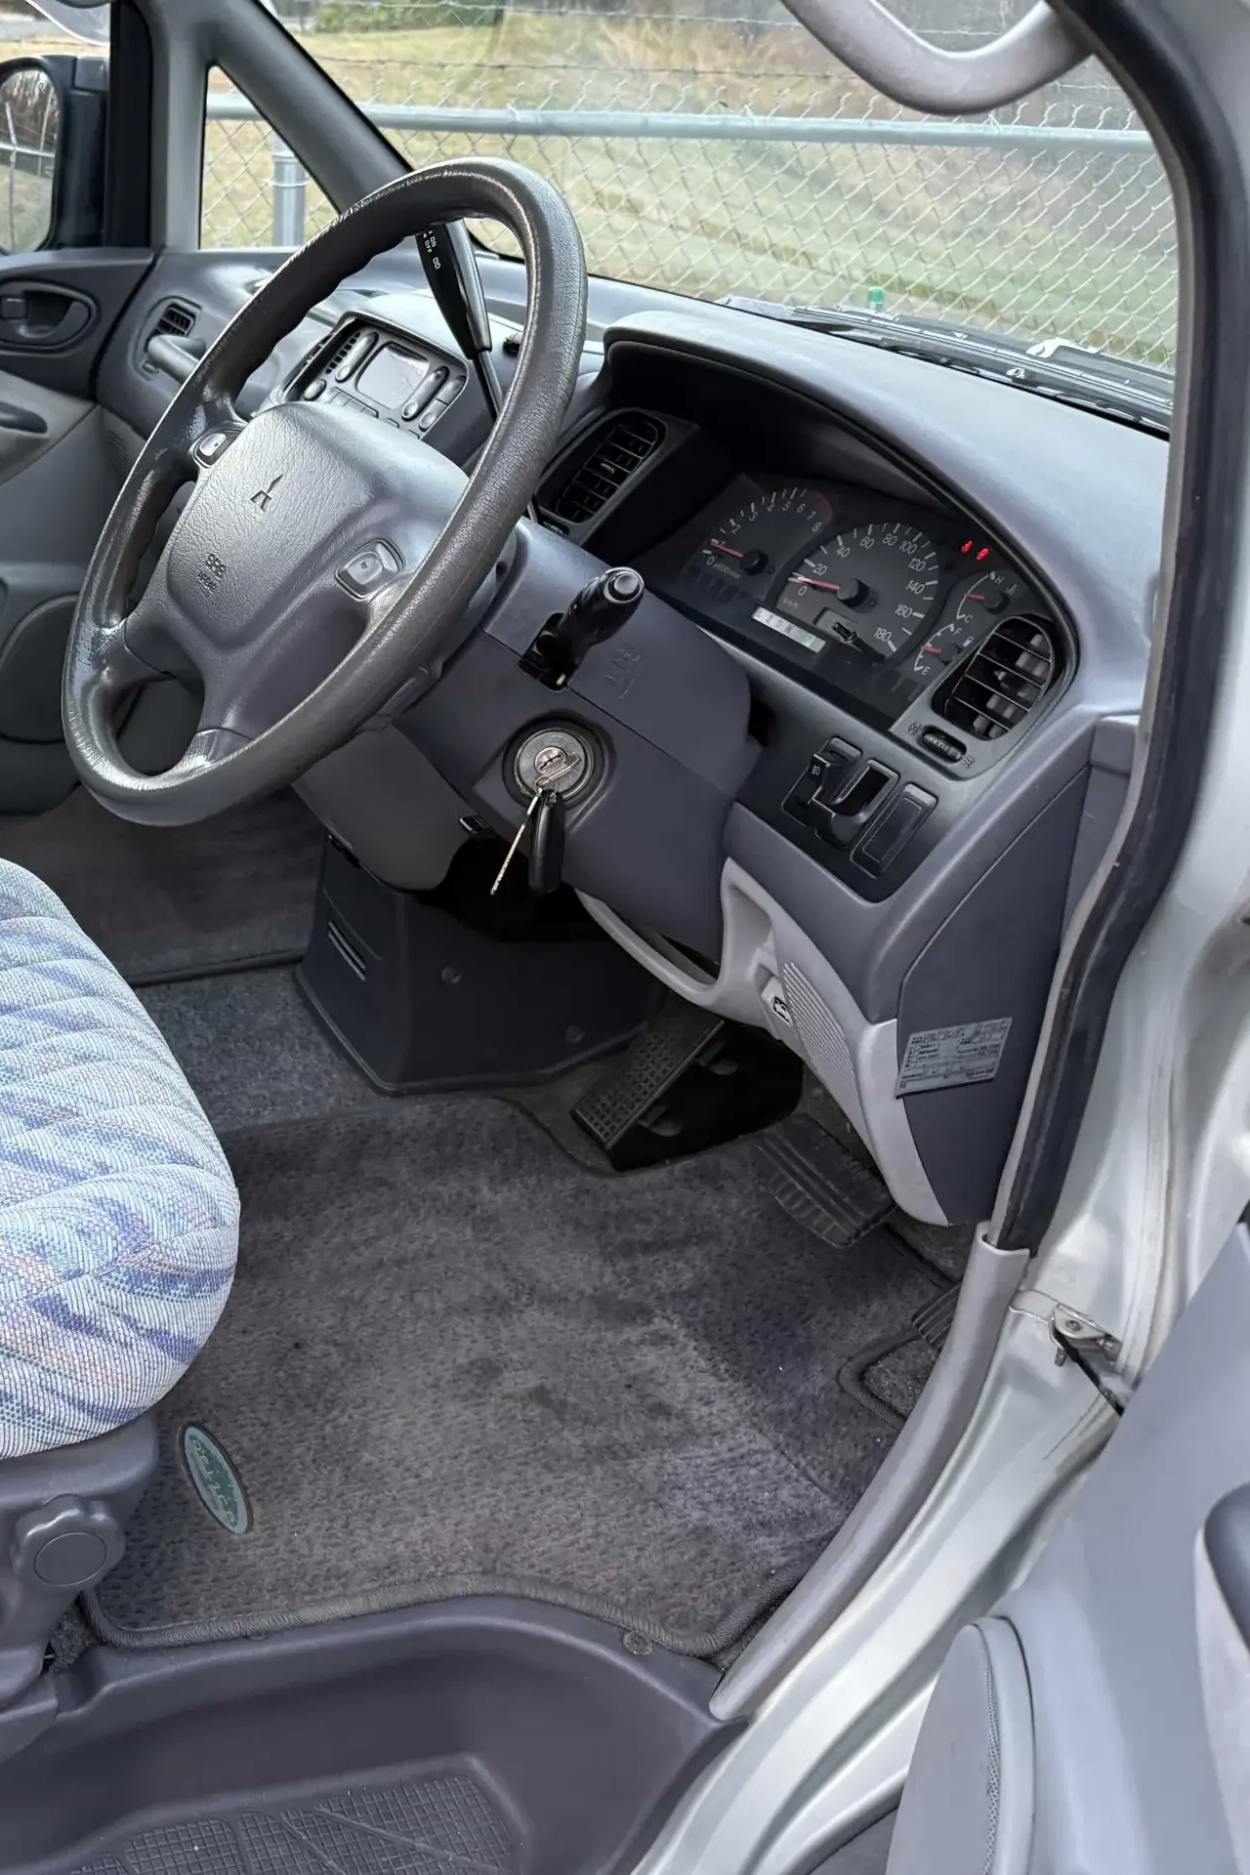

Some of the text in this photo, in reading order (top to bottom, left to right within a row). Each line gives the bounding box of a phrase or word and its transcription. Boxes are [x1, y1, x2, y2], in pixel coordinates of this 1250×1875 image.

[782, 501, 791, 512] 5
[796, 503, 806, 514] 6
[748, 511, 758, 521] 3
[807, 510, 817, 520] 7
[731, 524, 741, 534] 2
[812, 521, 822, 532] 8
[860, 536, 875, 549] 60
[882, 533, 898, 546] 80
[836, 546, 851, 558] 40
[898, 540, 917, 555] 100
[706, 555, 715, 566] 0
[908, 557, 926, 572] 120
[812, 562, 828, 576] 20
[994, 575, 1005, 585] H
[798, 585, 808, 596] 0
[906, 580, 925, 595] 140
[895, 604, 913, 619] 160
[964, 614, 973, 624] C
[874, 627, 892, 642] 180
[953, 627, 962, 635] F
[922, 666, 931, 676] E
